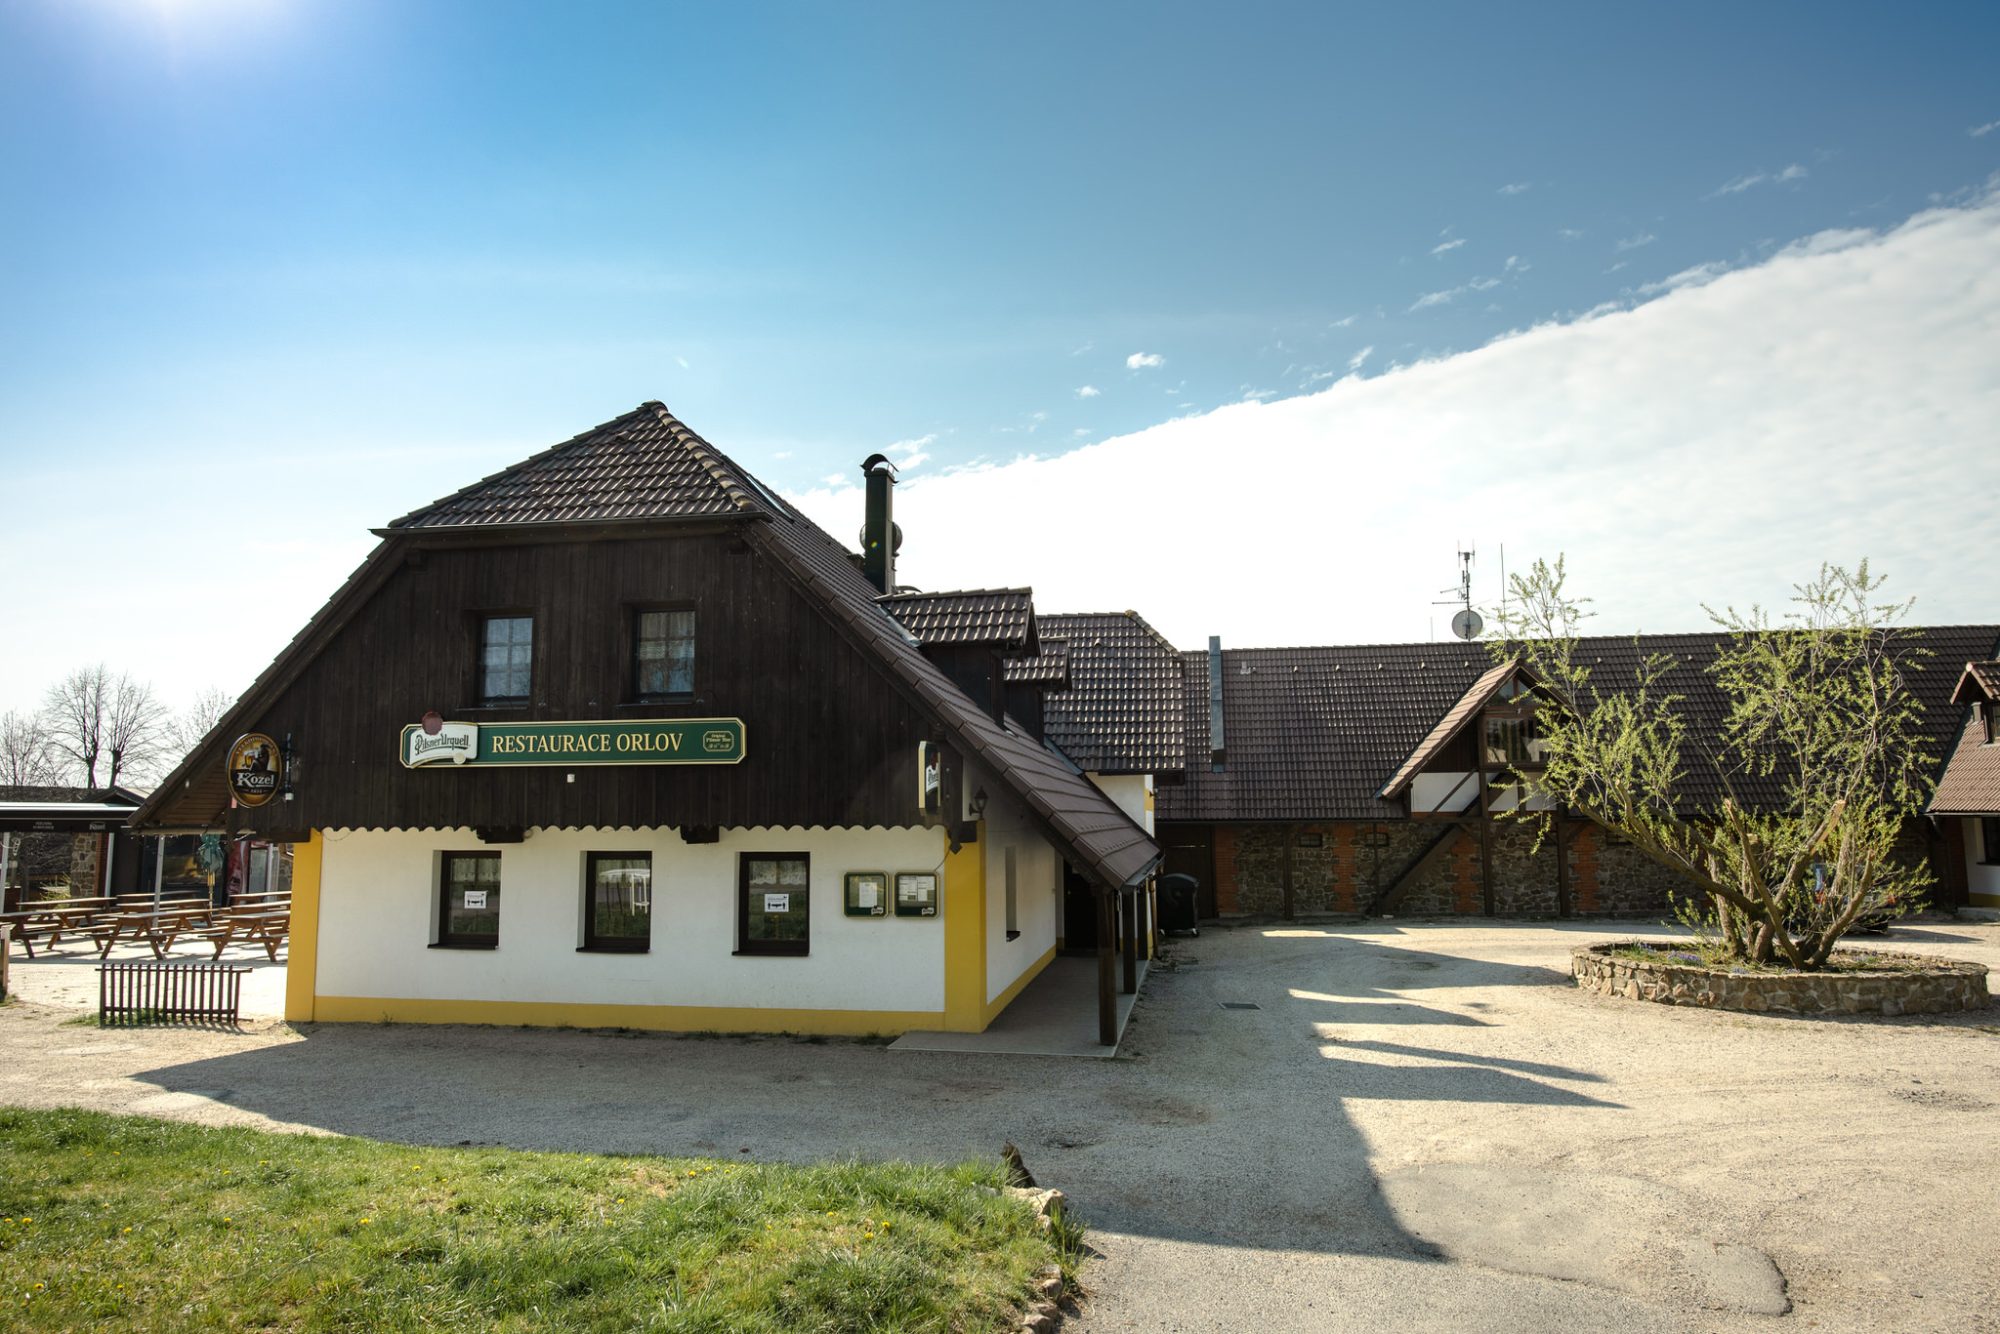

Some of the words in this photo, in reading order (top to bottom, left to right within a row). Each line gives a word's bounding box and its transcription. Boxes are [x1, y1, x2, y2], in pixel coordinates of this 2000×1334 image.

[415, 733, 442, 756] Pilsner
[441, 733, 469, 750] Urquell
[491, 733, 612, 753] RESTAURACE
[616, 732, 683, 752] ORLOV
[236, 772, 275, 788] Kozel
